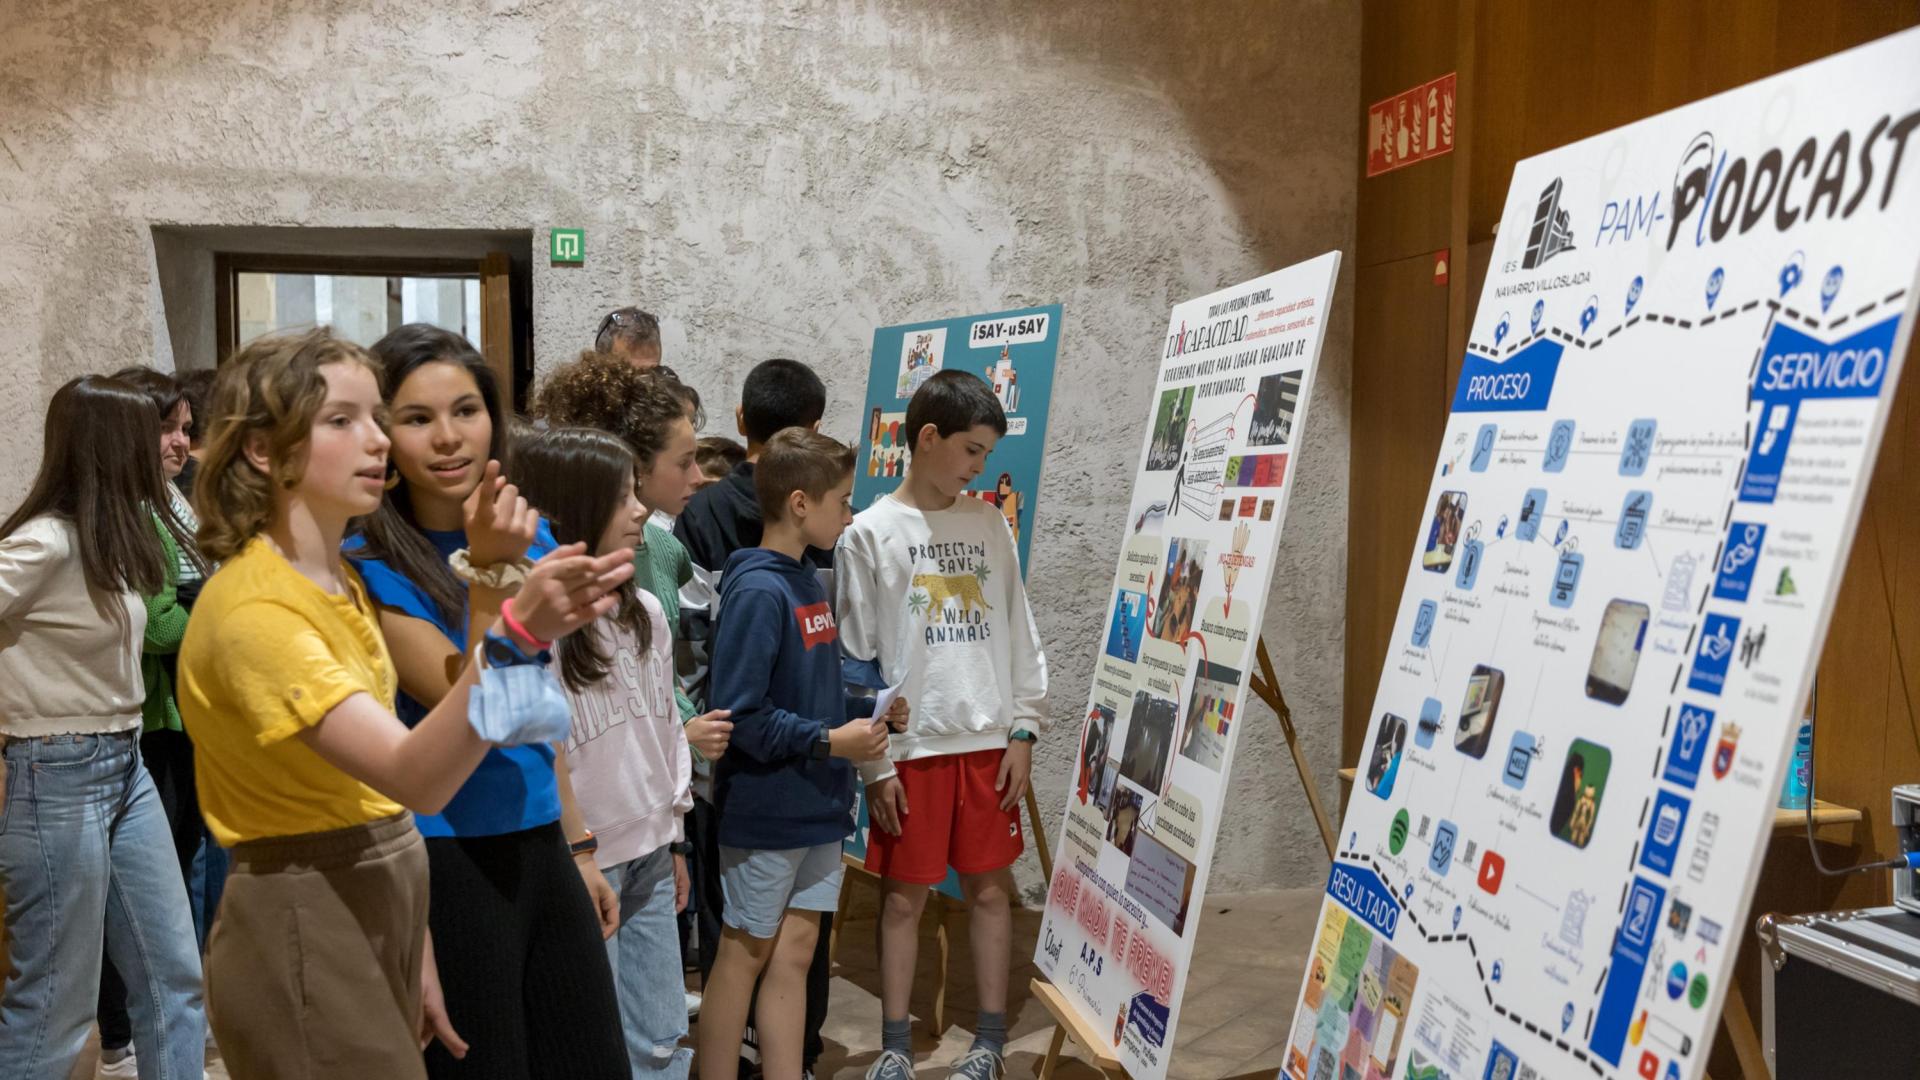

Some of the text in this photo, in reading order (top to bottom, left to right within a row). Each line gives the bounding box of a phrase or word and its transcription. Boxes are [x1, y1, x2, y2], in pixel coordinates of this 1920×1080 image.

[1495, 272, 1592, 299] NAVARRO VILLOSLADA
[1166, 315, 1247, 357] DICAPACIDAD
[1196, 359, 1215, 376] MUROS
[1215, 355, 1232, 372] PARA
[1233, 349, 1257, 369] LOGRAR
[1259, 341, 1293, 363] IGUALDAD
[1295, 338, 1305, 355] DE
[1762, 347, 1885, 391] SERVICIO
[1466, 372, 1531, 401] PROCESO
[908, 541, 985, 565] PROTECT and
[938, 557, 974, 574] SAVE
[943, 607, 981, 625] WILD
[1200, 618, 1213, 633] Busca
[925, 622, 991, 646] ANIMALS
[1177, 803, 1188, 818] cabo
[1097, 876, 1106, 891] con
[1105, 883, 1119, 901] quien
[1122, 897, 1142, 921] necesite
[1331, 868, 1399, 936] RESULTADO
[1078, 888, 1111, 945] NADA
[1114, 912, 1129, 961] TE
[1044, 927, 1062, 963] Claret
[1080, 942, 1103, 975] A.P.S
[1077, 972, 1101, 1015] Primaria
